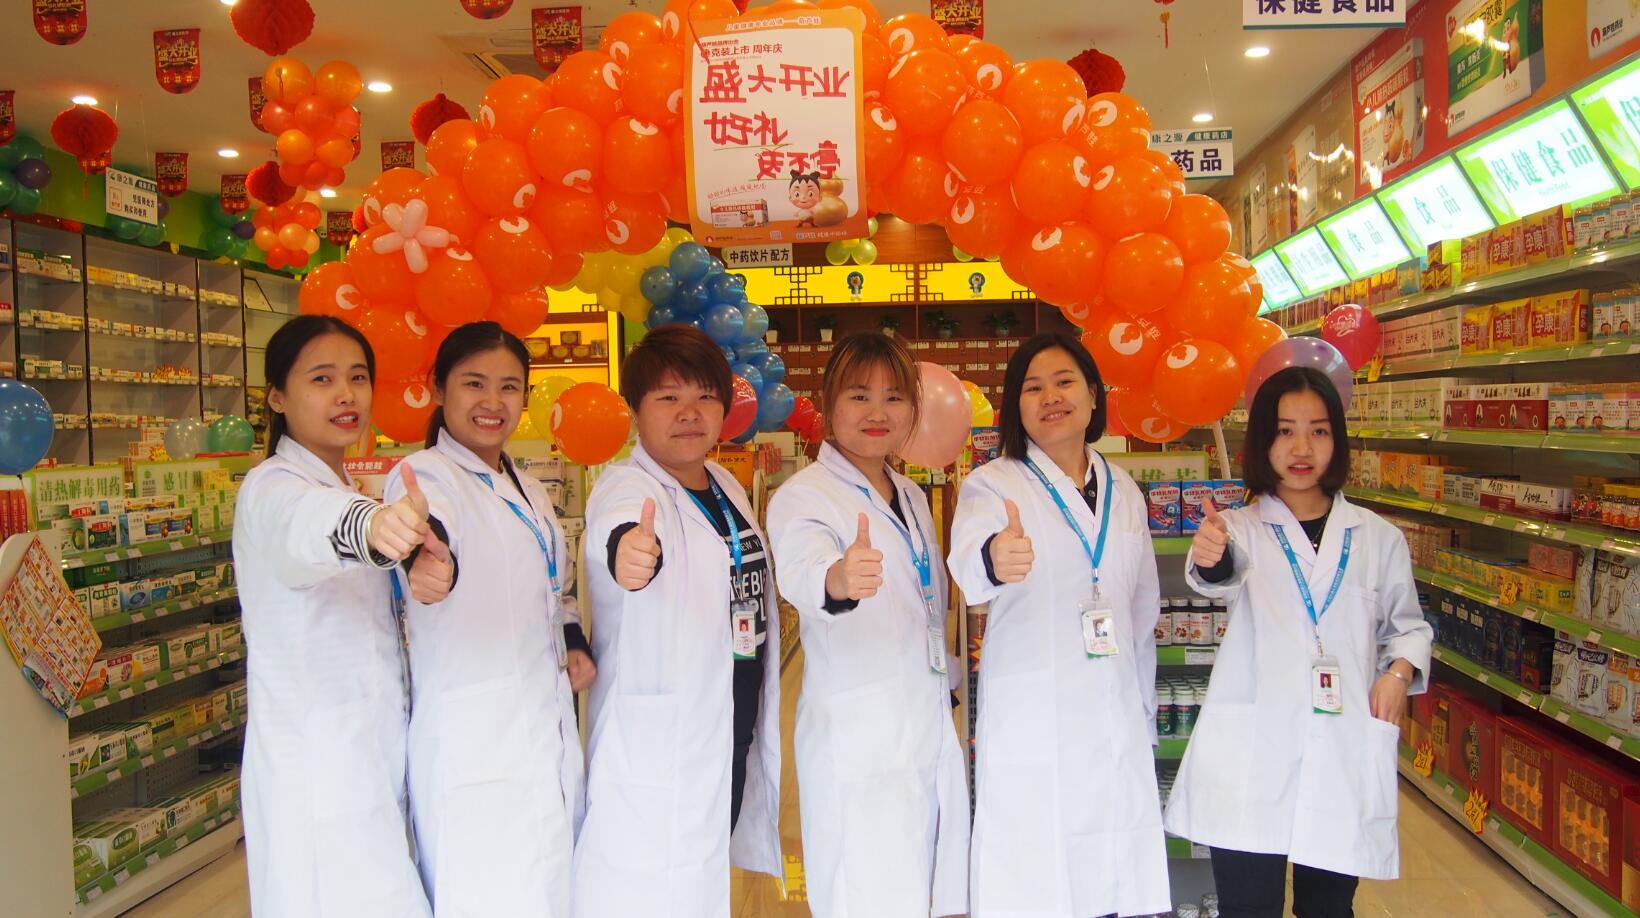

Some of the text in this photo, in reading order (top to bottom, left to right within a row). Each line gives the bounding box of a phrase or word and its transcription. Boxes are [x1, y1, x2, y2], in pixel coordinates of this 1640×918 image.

[934, 1, 982, 21] 盛大开业
[535, 23, 580, 40] 盛大开业
[158, 45, 198, 62] 盛大开业
[753, 43, 783, 54] 周年庆
[699, 59, 850, 103] 盛大开业
[704, 111, 788, 145] 好礼
[757, 140, 840, 181] 送不停
[1171, 149, 1222, 173] 药品
[1491, 127, 1594, 193] 保健食品
[730, 249, 790, 263] 中药饮片配方
[1495, 319, 1512, 338] 孕康
[1535, 313, 1554, 333] 孕康
[40, 477, 121, 502] 清热解毒用药
